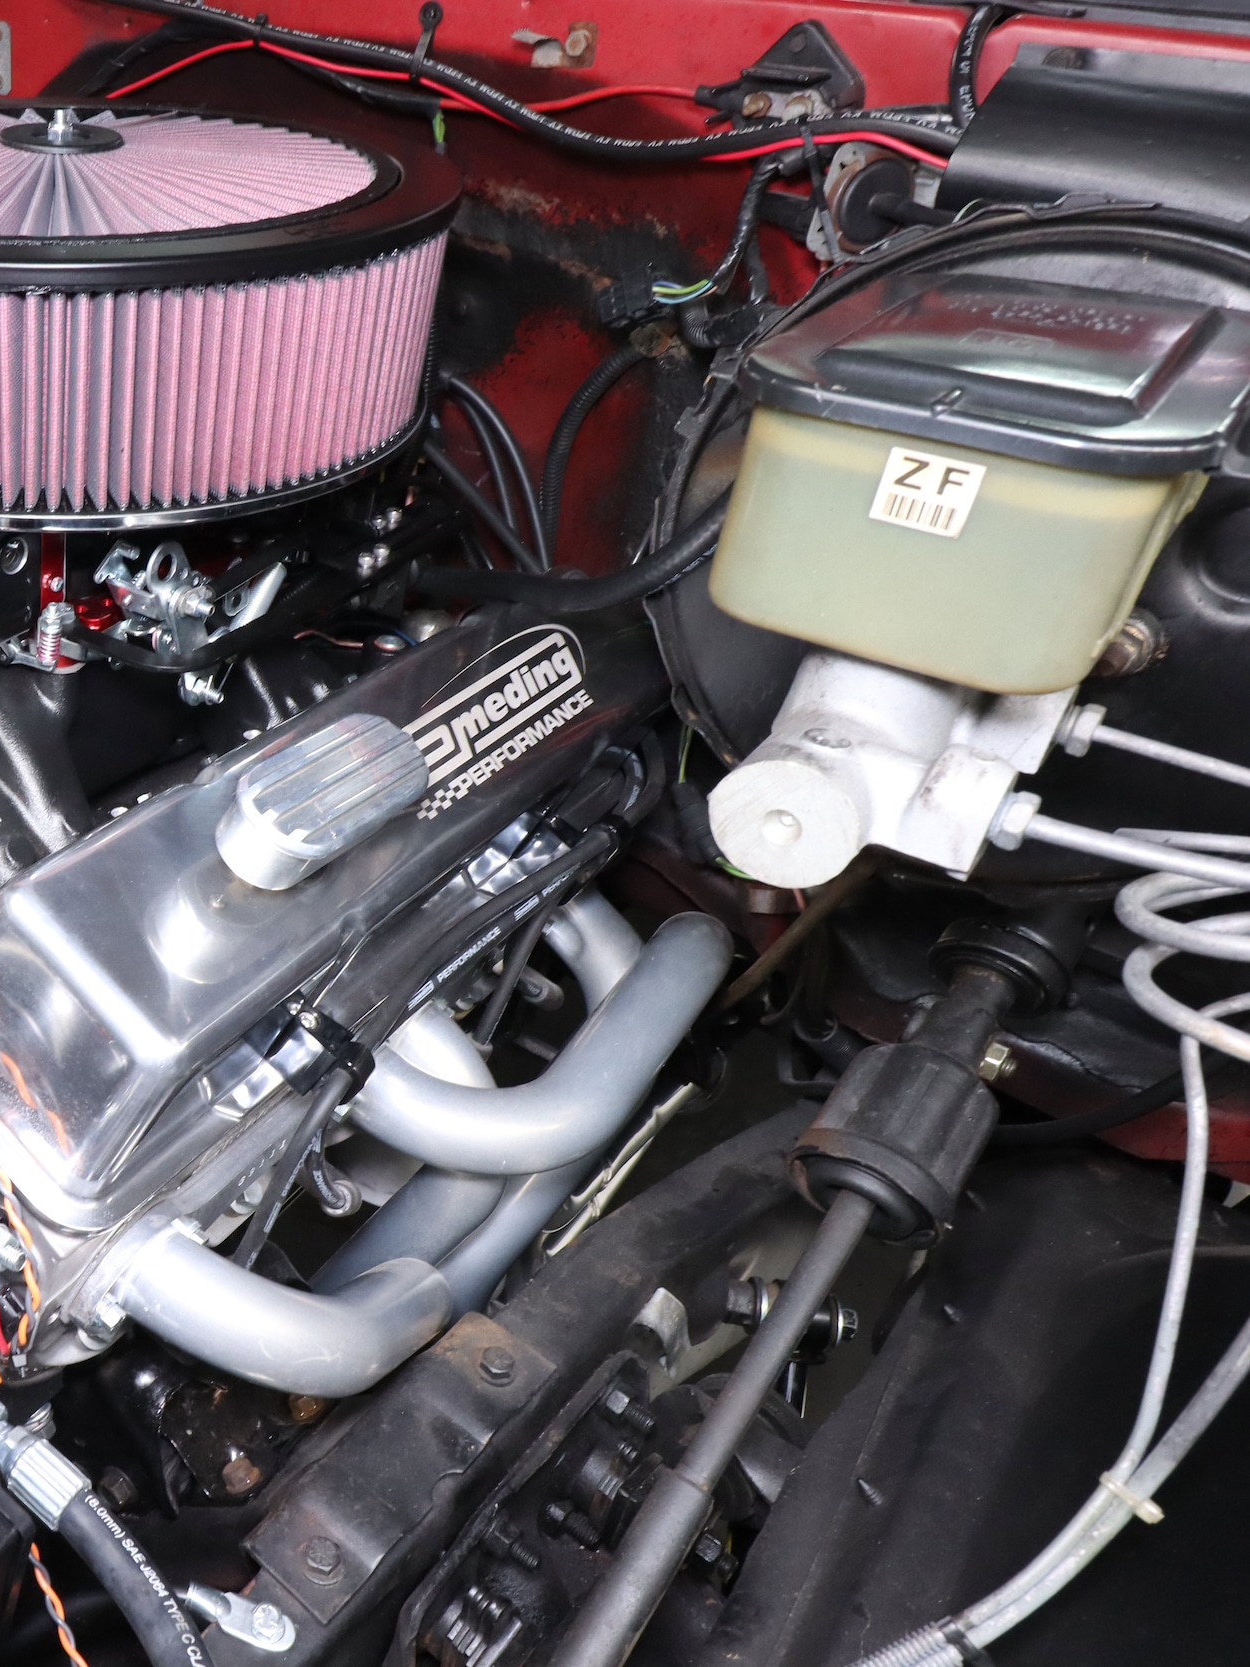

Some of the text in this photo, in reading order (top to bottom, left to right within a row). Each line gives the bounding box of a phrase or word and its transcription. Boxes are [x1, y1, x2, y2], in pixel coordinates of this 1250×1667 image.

[459, 688, 594, 789] PERFORMANCE
[436, 925, 502, 984] PERFORMANCE
[84, 1495, 126, 1538] (8.0mm)
[121, 1538, 146, 1564] SAE
[139, 1563, 170, 1598] J2064
[163, 1599, 190, 1632] TYPE
[181, 1633, 196, 1644] C
